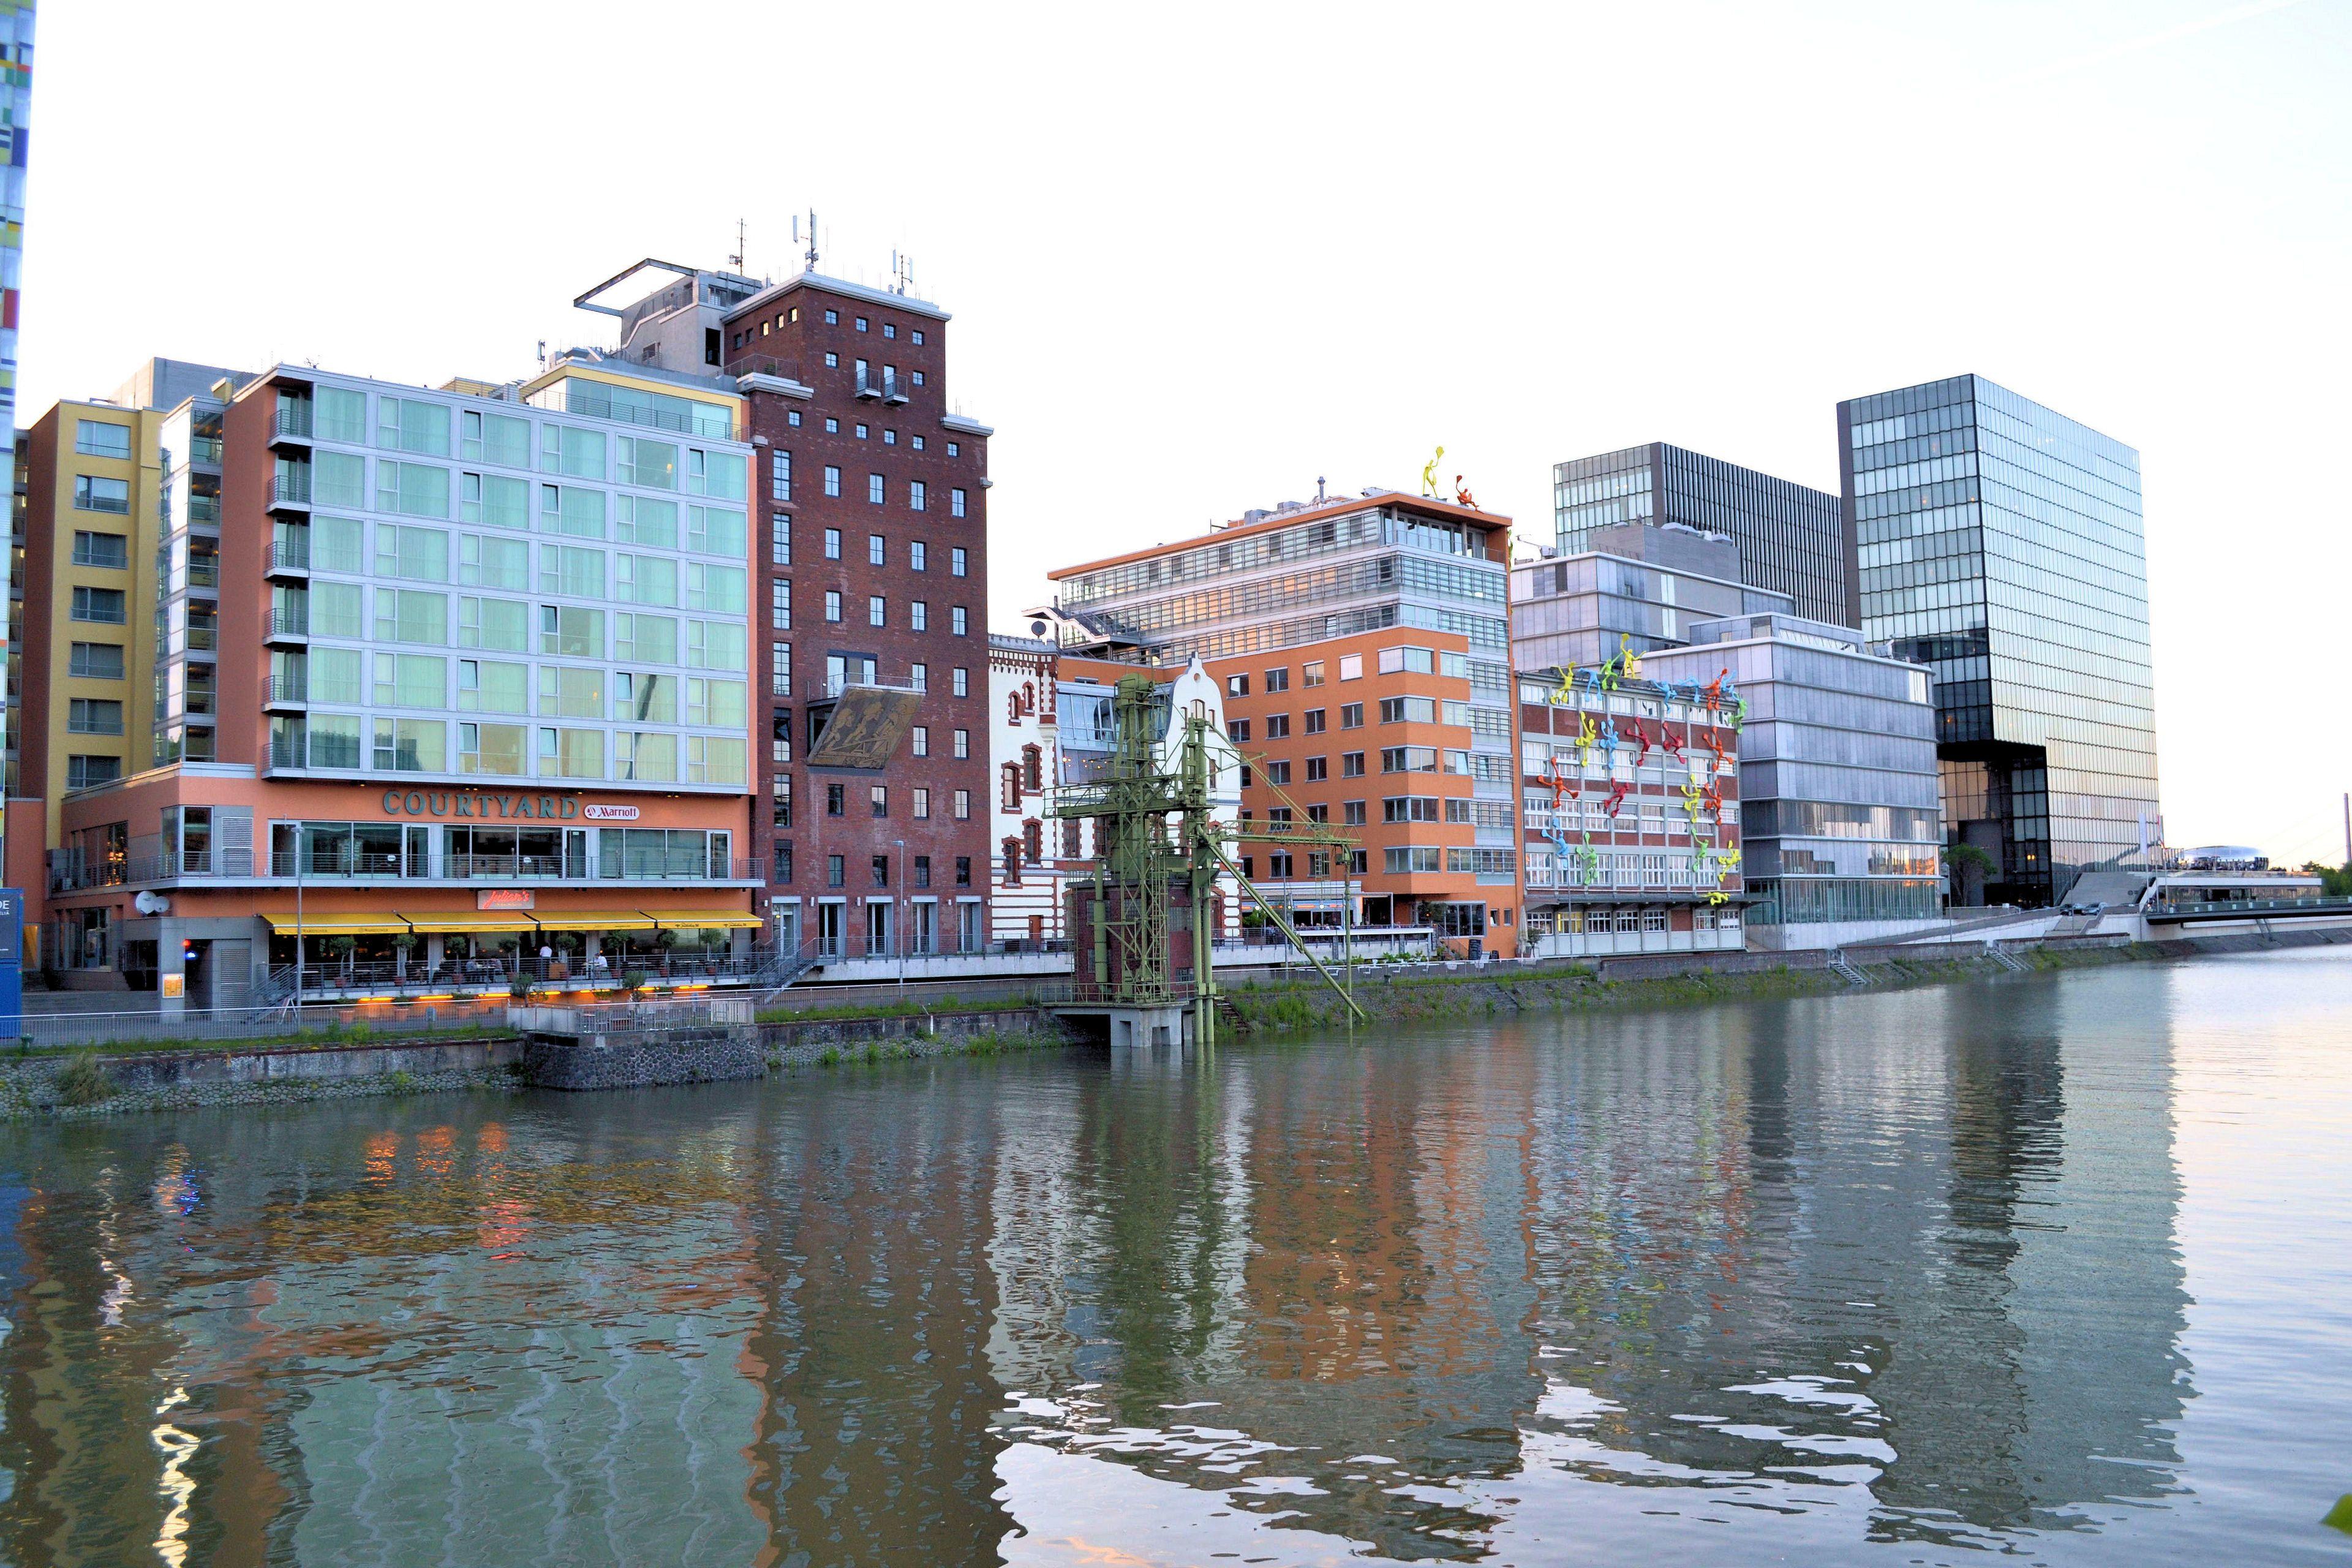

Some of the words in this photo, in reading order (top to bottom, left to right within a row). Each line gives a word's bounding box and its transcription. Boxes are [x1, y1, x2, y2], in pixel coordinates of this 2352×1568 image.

[383, 791, 579, 818] COURTYARD
[598, 807, 636, 817] Marriott
[483, 889, 529, 908] Julian's
